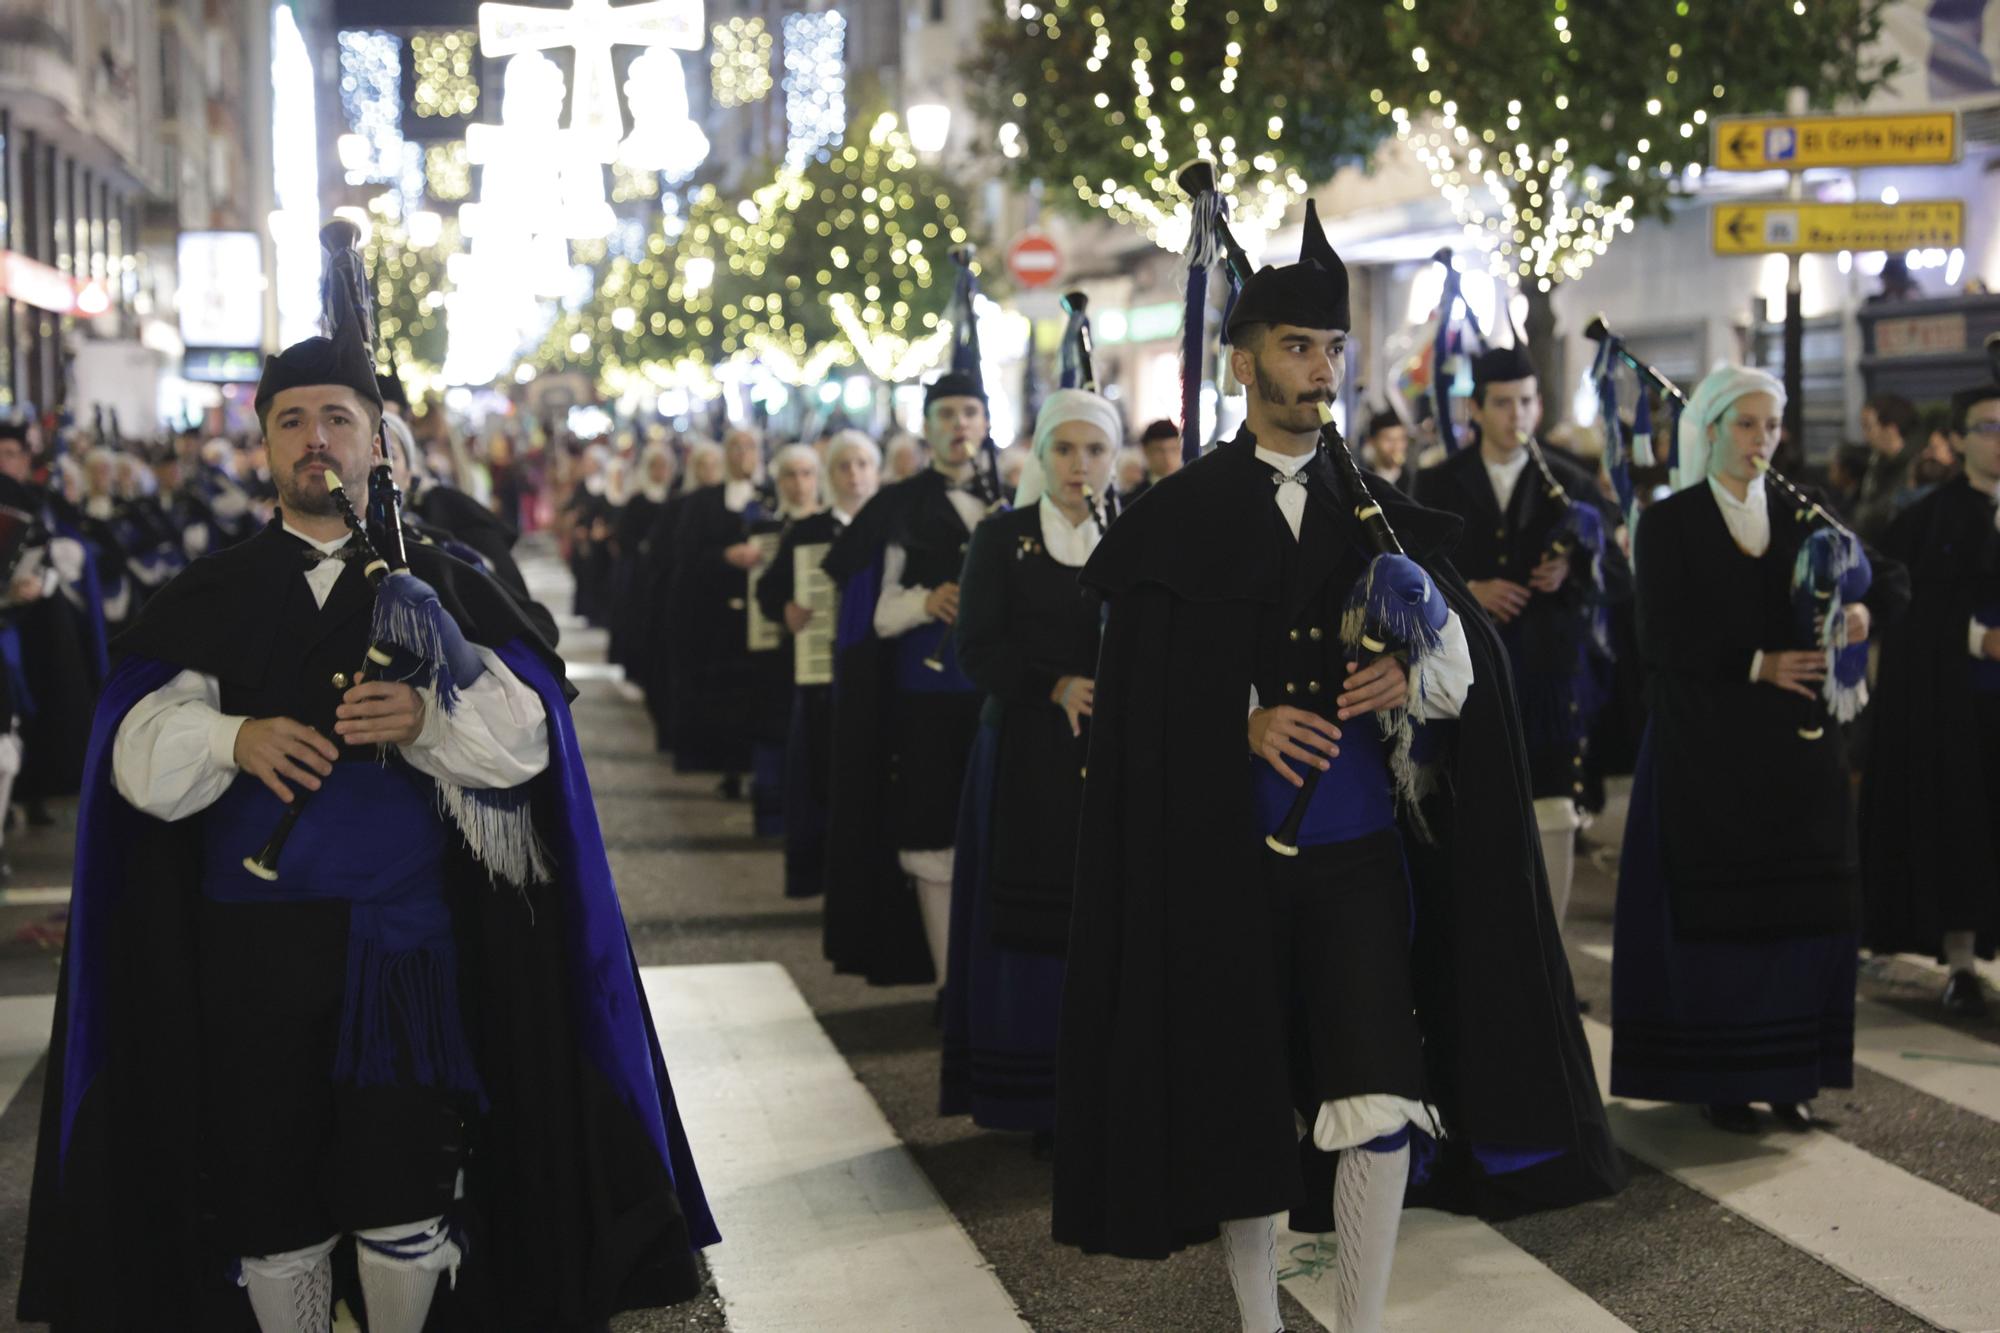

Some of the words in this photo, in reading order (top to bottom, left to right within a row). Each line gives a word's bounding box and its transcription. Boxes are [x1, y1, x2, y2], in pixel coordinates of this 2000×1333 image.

[1768, 128, 1793, 160] P
[1804, 129, 1824, 151] El
[1828, 126, 1882, 150] Corte
